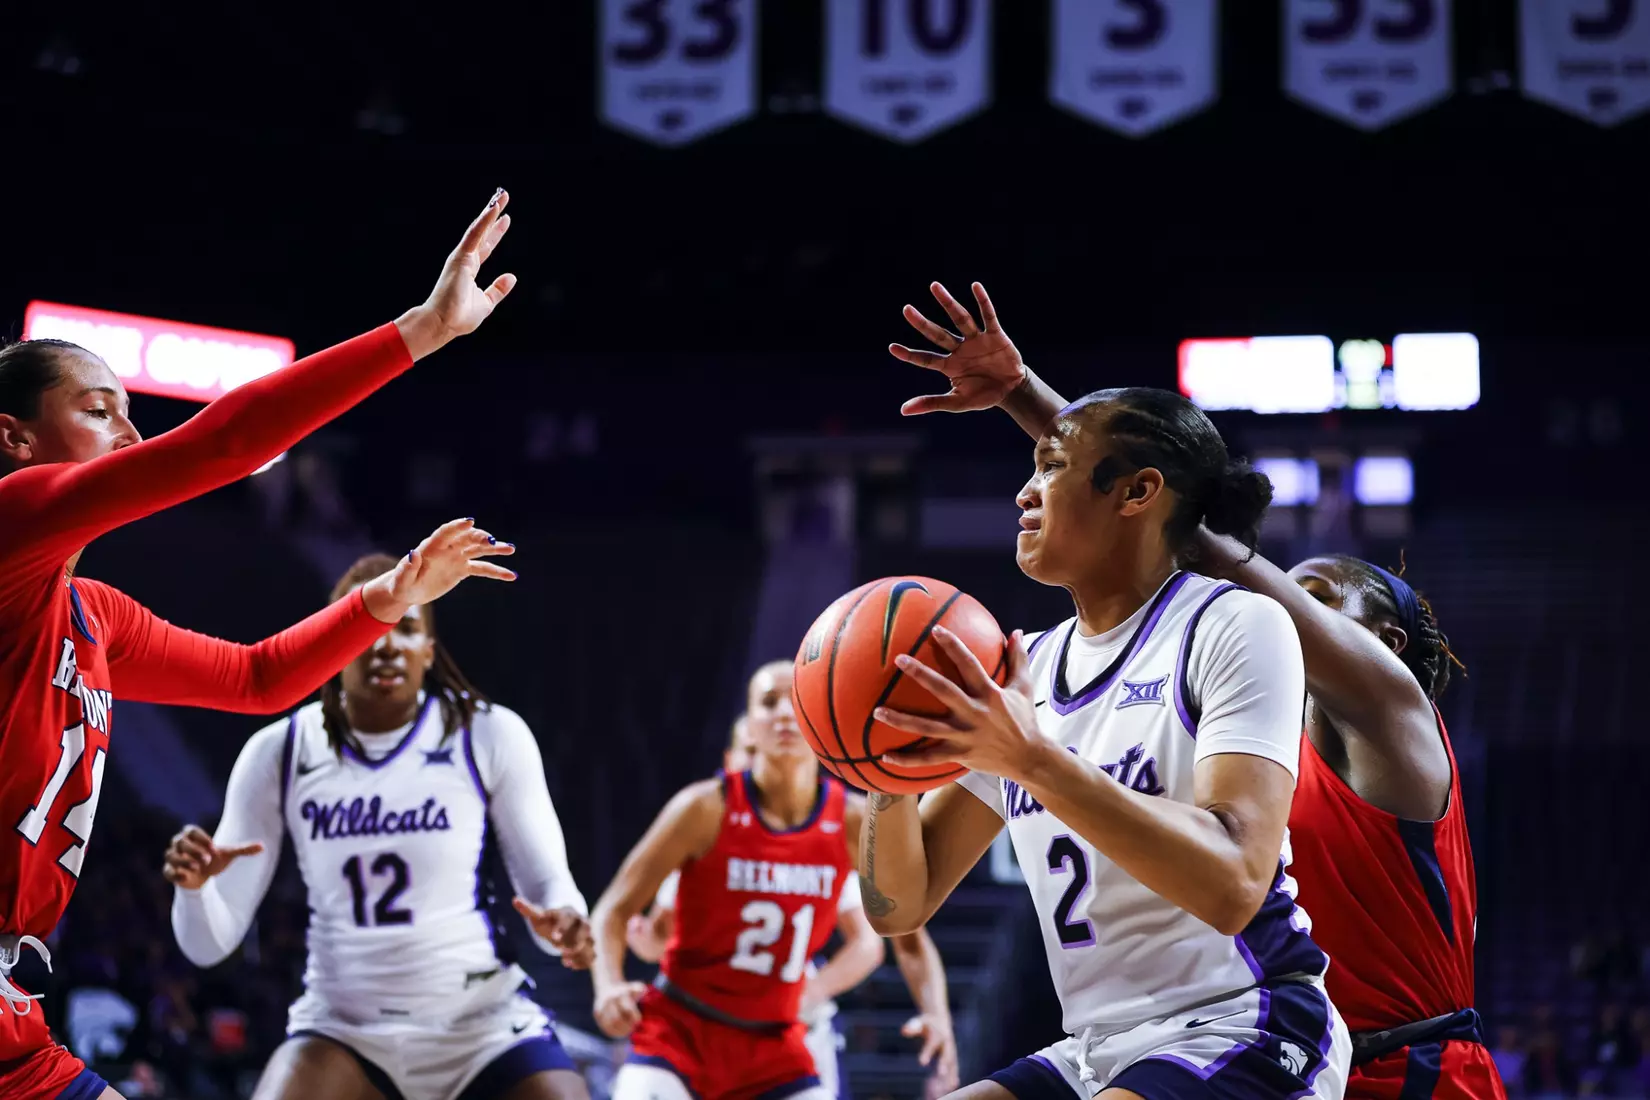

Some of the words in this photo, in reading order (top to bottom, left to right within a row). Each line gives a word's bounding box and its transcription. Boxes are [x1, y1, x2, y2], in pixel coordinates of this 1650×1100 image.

[301, 795, 452, 840] Wildcats
[342, 852, 414, 927] 12
[727, 857, 838, 899] BELMONT
[1046, 834, 1096, 949] 2
[729, 900, 815, 983] 21
